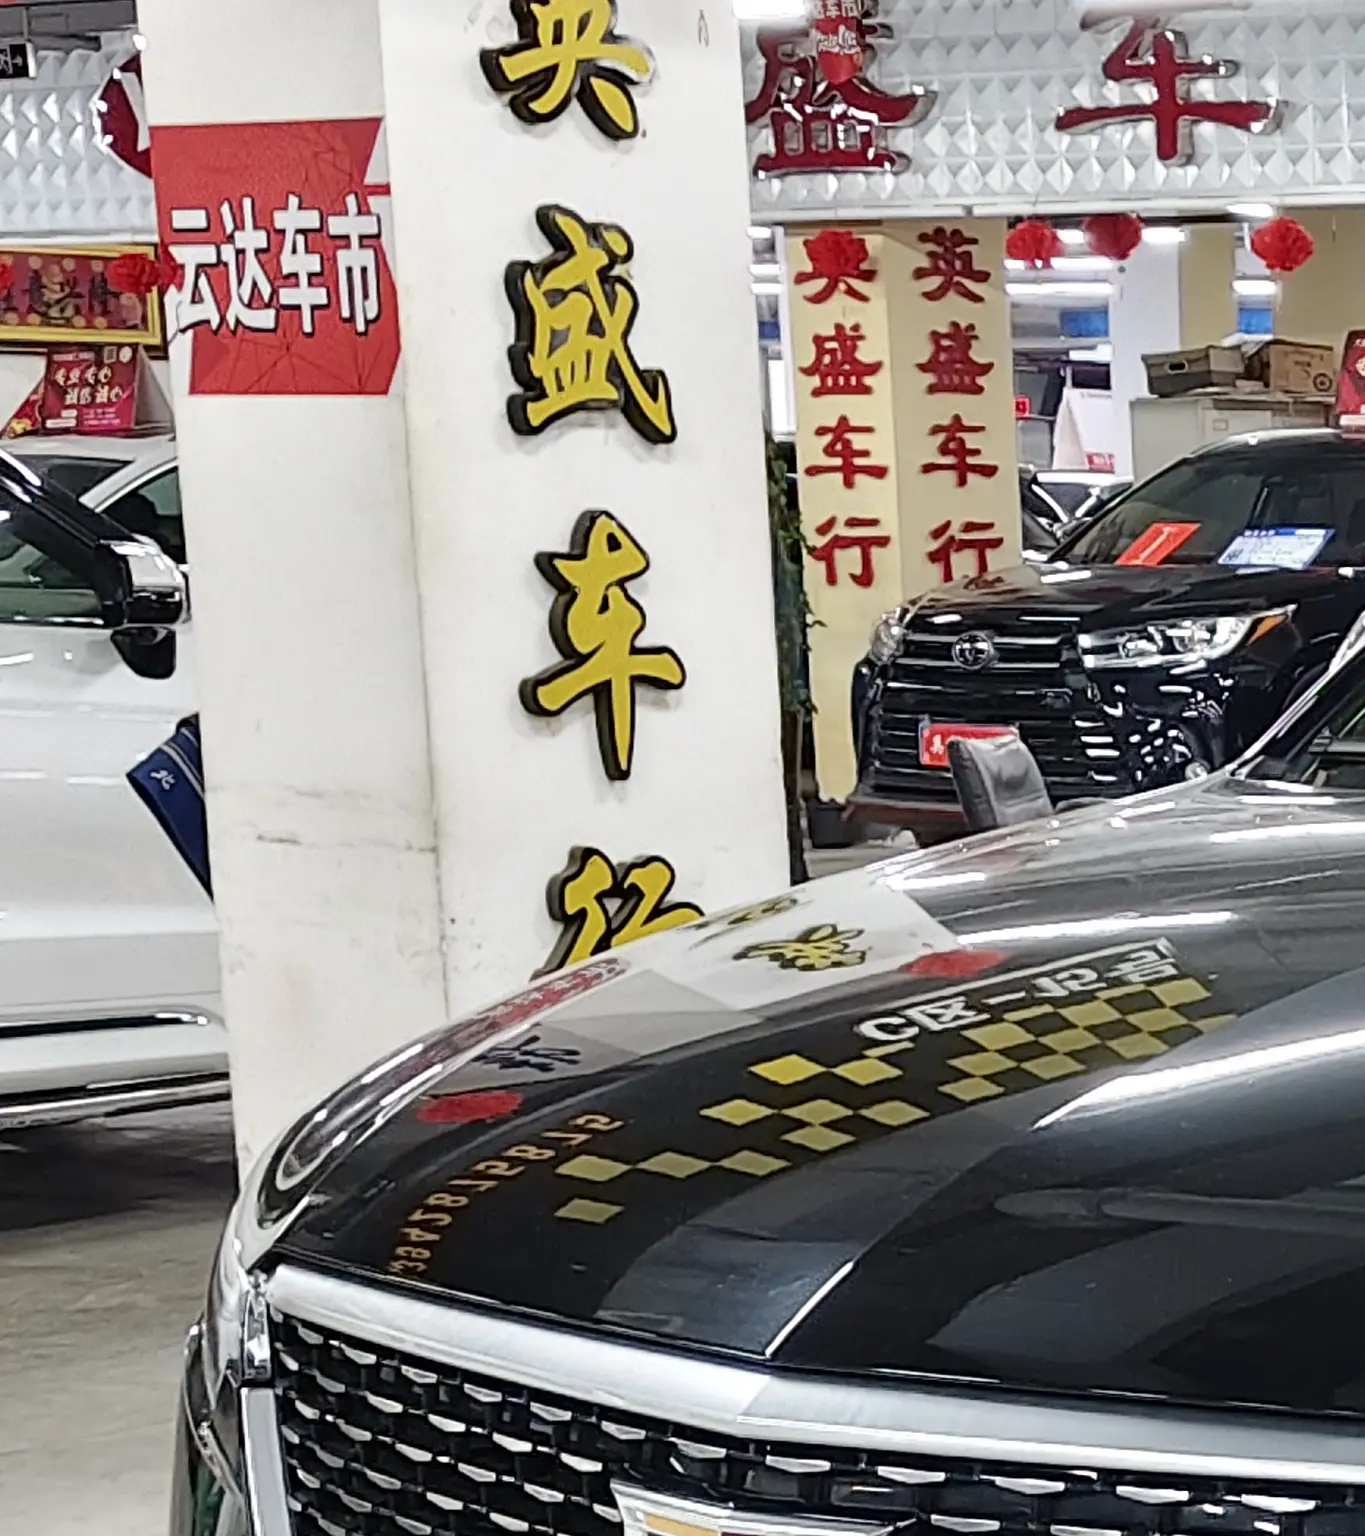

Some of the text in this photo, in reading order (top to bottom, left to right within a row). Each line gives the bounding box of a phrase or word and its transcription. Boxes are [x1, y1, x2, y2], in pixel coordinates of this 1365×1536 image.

[165, 193, 382, 337] 云达车市
[911, 226, 1005, 585] 英盛车行
